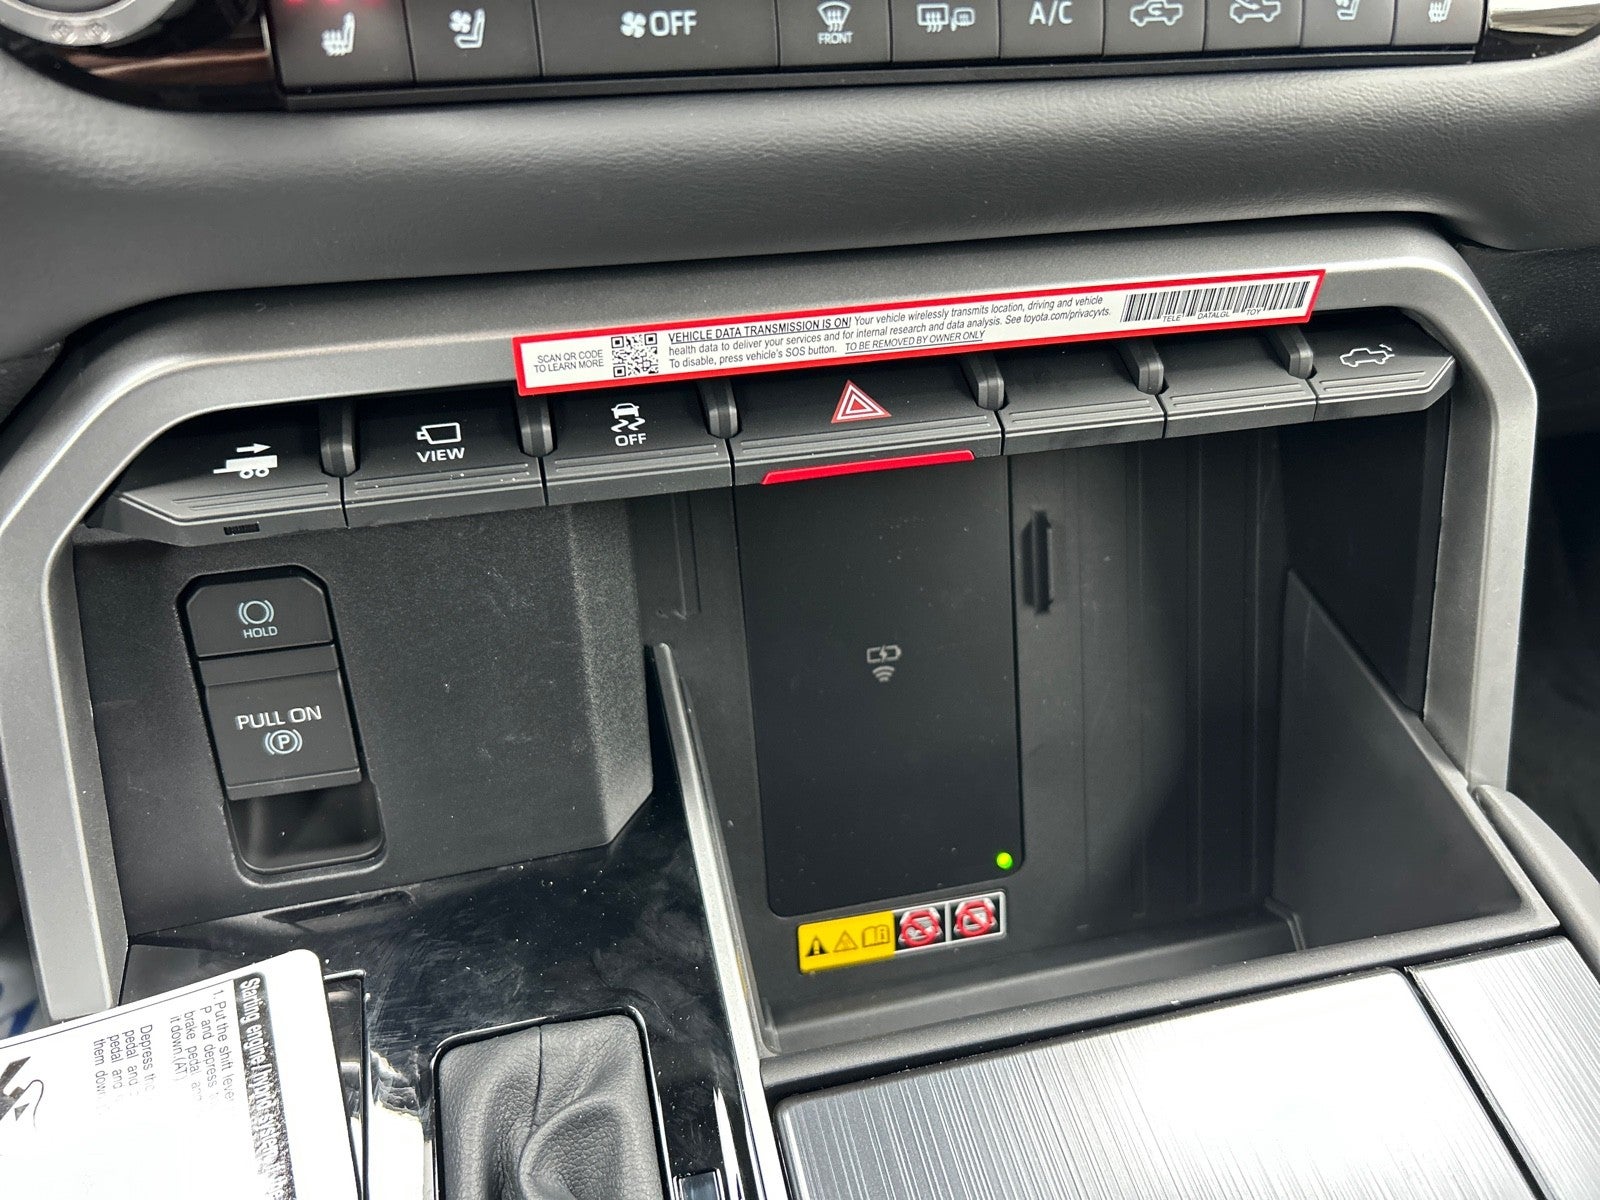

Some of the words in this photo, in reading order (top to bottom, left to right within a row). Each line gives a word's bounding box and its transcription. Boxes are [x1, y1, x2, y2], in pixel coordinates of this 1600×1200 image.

[649, 9, 697, 36] OFF
[1028, 1, 1074, 26] A/C
[817, 31, 853, 44] FRONT
[668, 329, 713, 343] VEHICLE
[715, 327, 742, 339] DATA
[744, 320, 820, 337] TRANSMISSION
[822, 319, 832, 329] IS
[834, 316, 851, 328] ON!
[854, 315, 874, 326] Your
[876, 312, 906, 324] vehicle
[908, 308, 949, 322] wirelessly
[951, 305, 989, 317] transmits
[991, 302, 1025, 314] location,
[1027, 299, 1055, 312] driving
[1057, 297, 1073, 307] and
[1075, 295, 1103, 306] vehicle
[1161, 313, 1182, 323] TELE
[1246, 307, 1263, 317] TOY
[668, 345, 697, 356] health
[699, 342, 718, 353] data
[721, 341, 730, 351] to
[733, 338, 762, 350] deliver
[764, 337, 783, 349] your
[786, 332, 821, 345] services
[824, 329, 840, 341] and
[842, 328, 854, 339] for
[856, 326, 888, 338] internal
[889, 322, 926, 335] research
[928, 320, 944, 332] and
[946, 318, 965, 330] data
[967, 316, 1003, 329] analysis.
[1005, 314, 1022, 325] See
[845, 342, 858, 352] TO
[858, 340, 871, 350] BE
[872, 336, 915, 349] REMOVED
[916, 335, 929, 345] BY
[929, 331, 962, 344] OWNER
[962, 329, 986, 341] ONLY
[534, 363, 547, 374] TO
[548, 360, 578, 372] LEARN
[578, 358, 605, 370] MORE
[537, 353, 562, 364] SCAN
[578, 350, 604, 361] CODE
[669, 358, 680, 369] To
[682, 354, 717, 368] disable,
[719, 352, 744, 366] press
[746, 349, 783, 361] vehicle's
[785, 346, 806, 358] SOS
[807, 344, 837, 356] button.
[614, 433, 647, 447] OFF
[416, 447, 465, 463] VIEW
[243, 626, 278, 639] HOLD
[235, 710, 286, 730] PULL
[288, 705, 322, 723] ON
[213, 989, 225, 1000] 1.
[239, 977, 263, 1025] Starting
[170, 1014, 182, 1024] it
[200, 1004, 213, 1015] P
[214, 1000, 227, 1022] Put
[184, 1010, 198, 1040] brake
[201, 1019, 217, 1041] and
[216, 1024, 229, 1042] the
[93, 1038, 106, 1066] them
[107, 1034, 124, 1064] pedal
[122, 1029, 139, 1060] pedal
[139, 1024, 153, 1071] Depress
[185, 1044, 202, 1076] pedal
[203, 1043, 218, 1088] depress
[219, 1046, 234, 1072] shift
[112, 1068, 123, 1090] and
[127, 1065, 138, 1086] and
